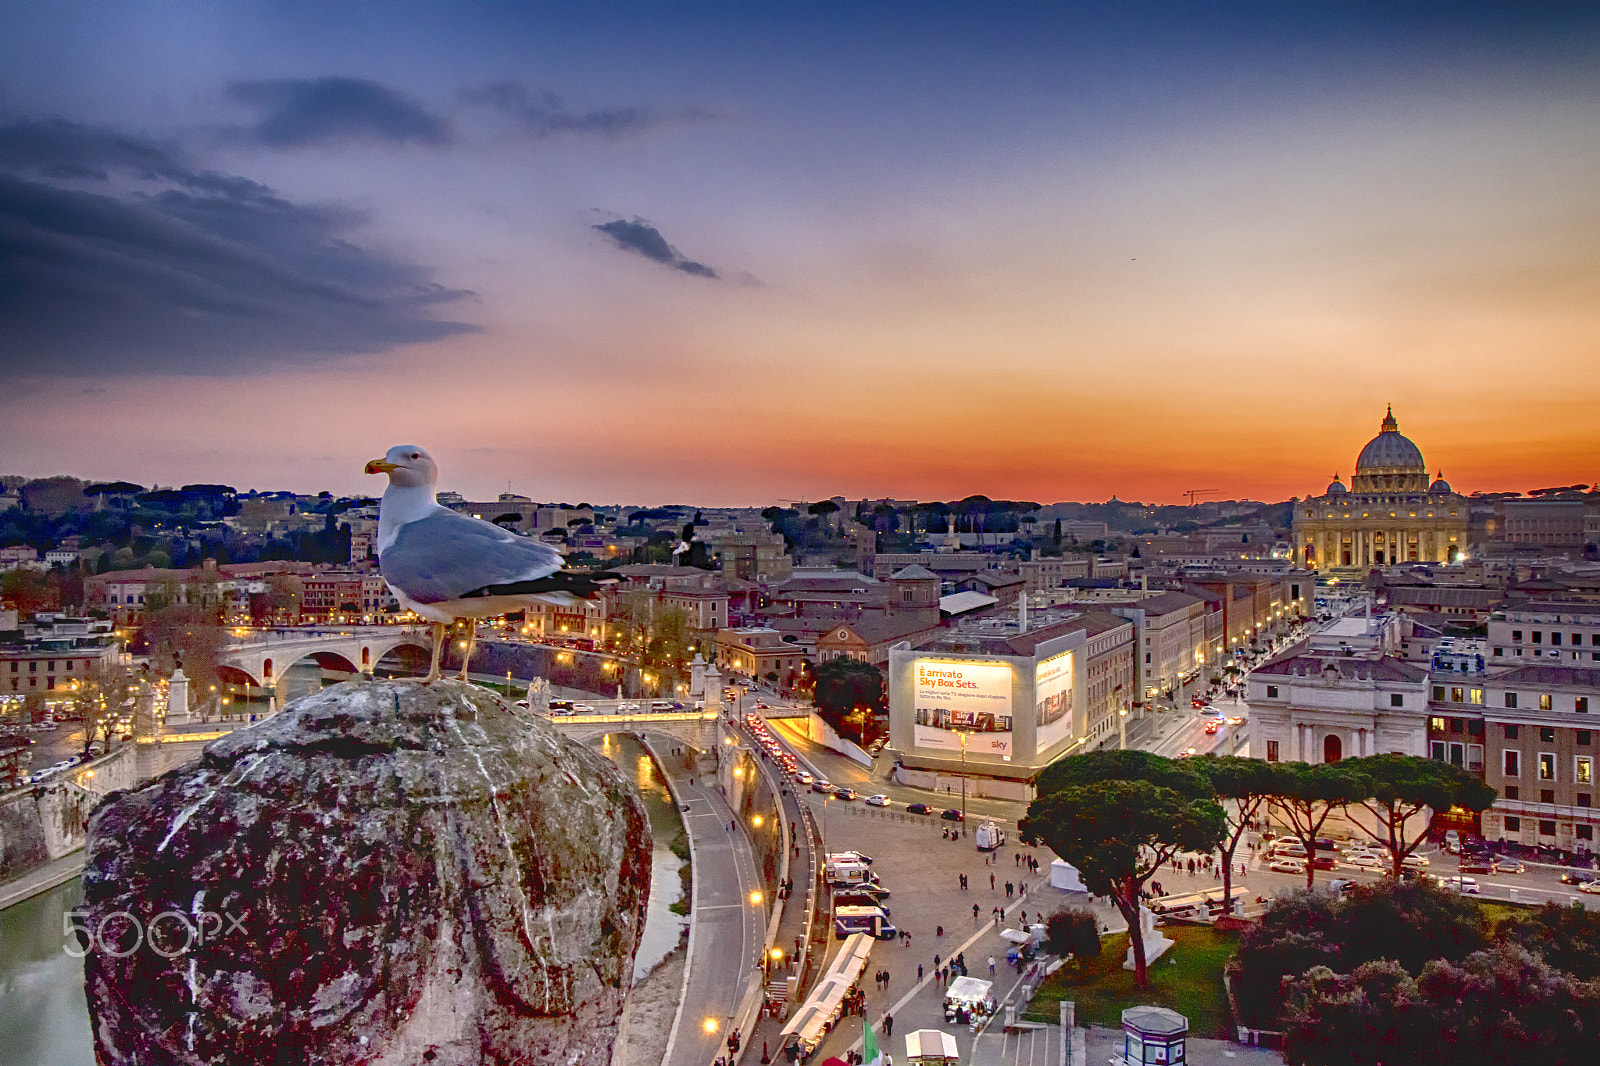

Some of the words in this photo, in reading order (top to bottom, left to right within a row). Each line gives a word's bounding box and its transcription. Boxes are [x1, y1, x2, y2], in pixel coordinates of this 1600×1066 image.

[919, 666, 925, 676] È
[926, 669, 963, 678] arrivato
[919, 677, 936, 688] Sky
[937, 678, 955, 688] Box
[956, 680, 979, 689] Sets.
[956, 711, 970, 720] sky
[991, 740, 1008, 750] sky
